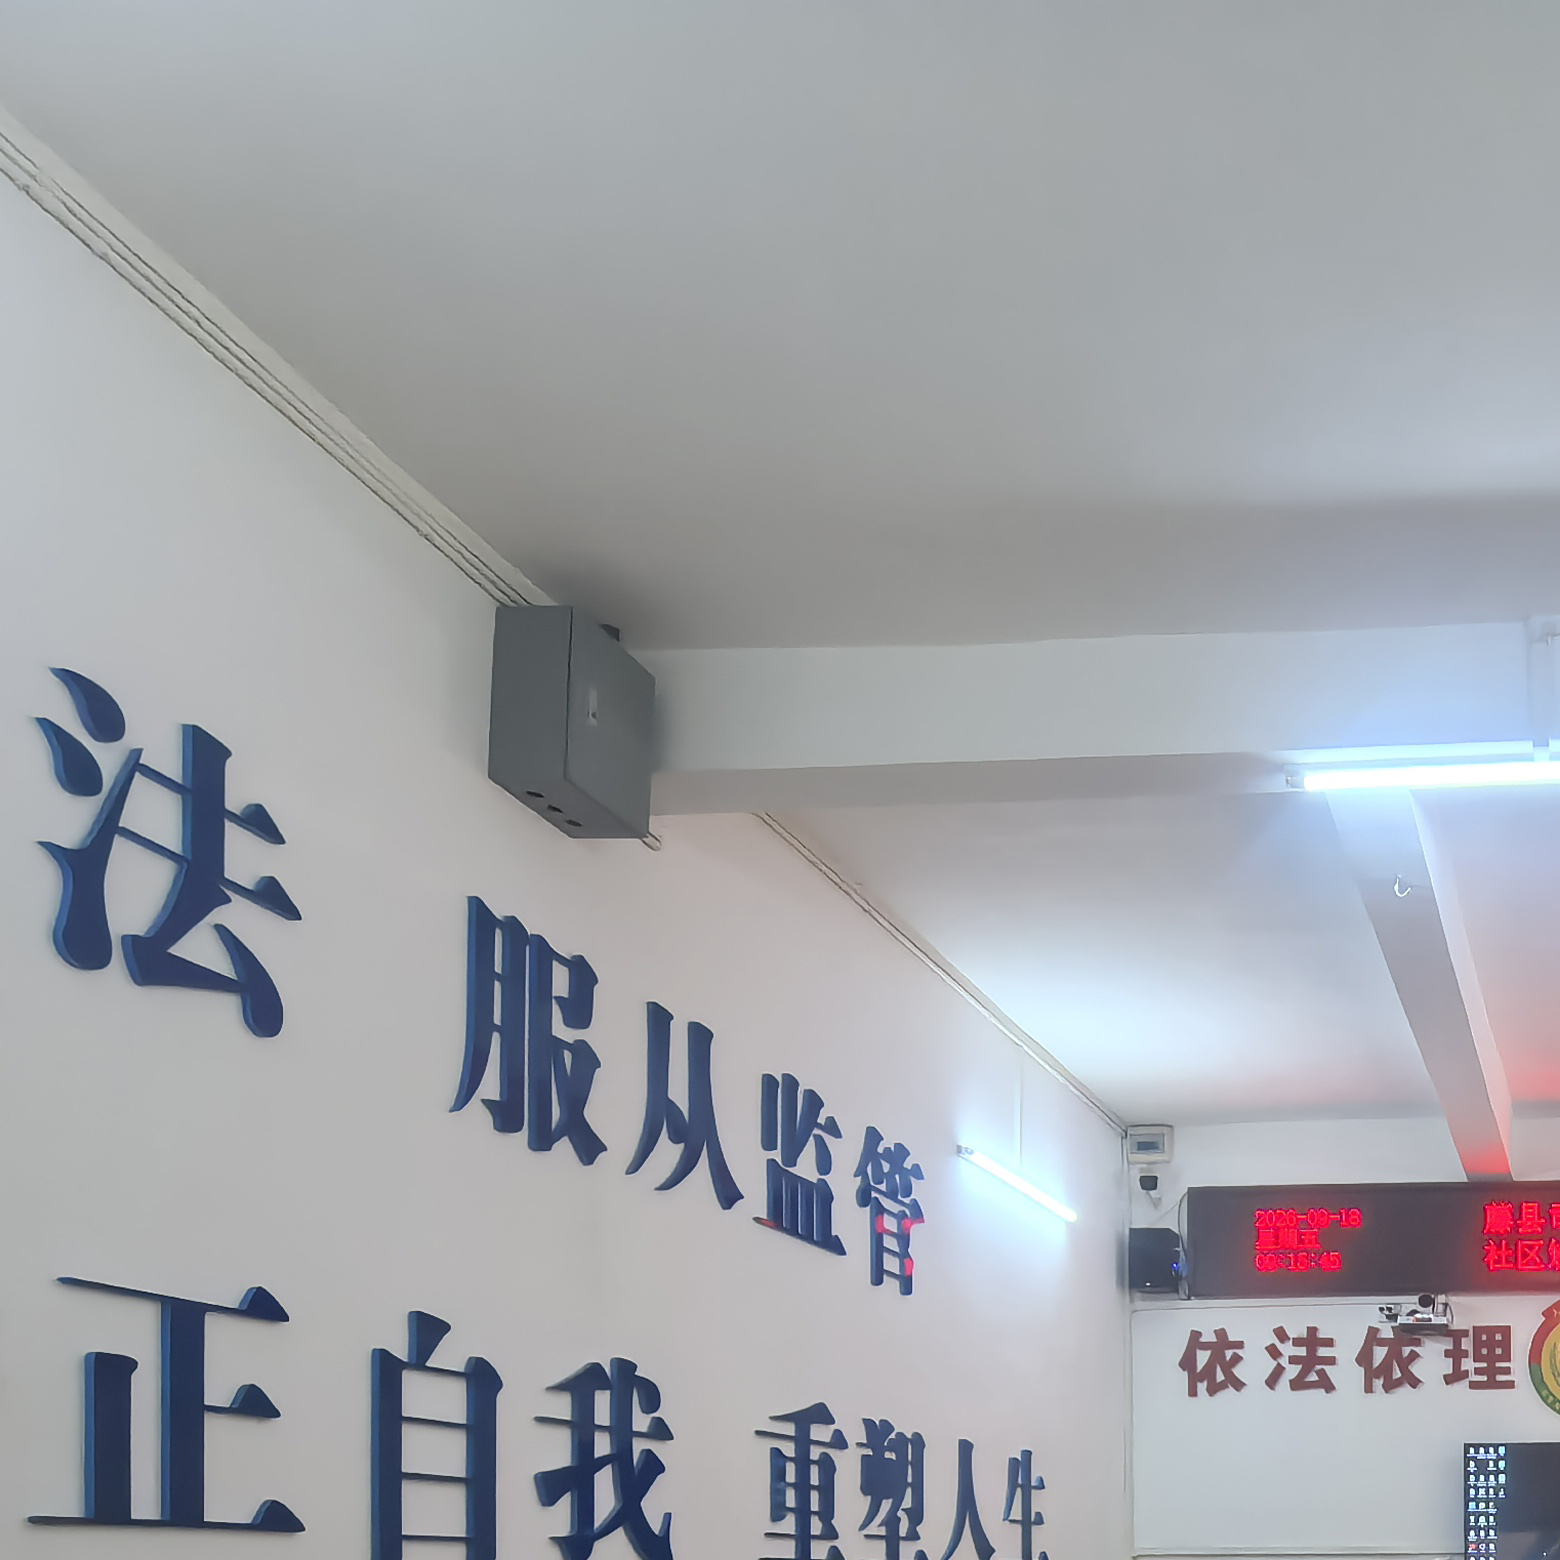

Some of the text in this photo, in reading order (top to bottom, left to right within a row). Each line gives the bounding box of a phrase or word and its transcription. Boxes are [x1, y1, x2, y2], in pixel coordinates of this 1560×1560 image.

[33, 667, 925, 1295] 法 服从监管
[1178, 1325, 1515, 1397] 依法依理
